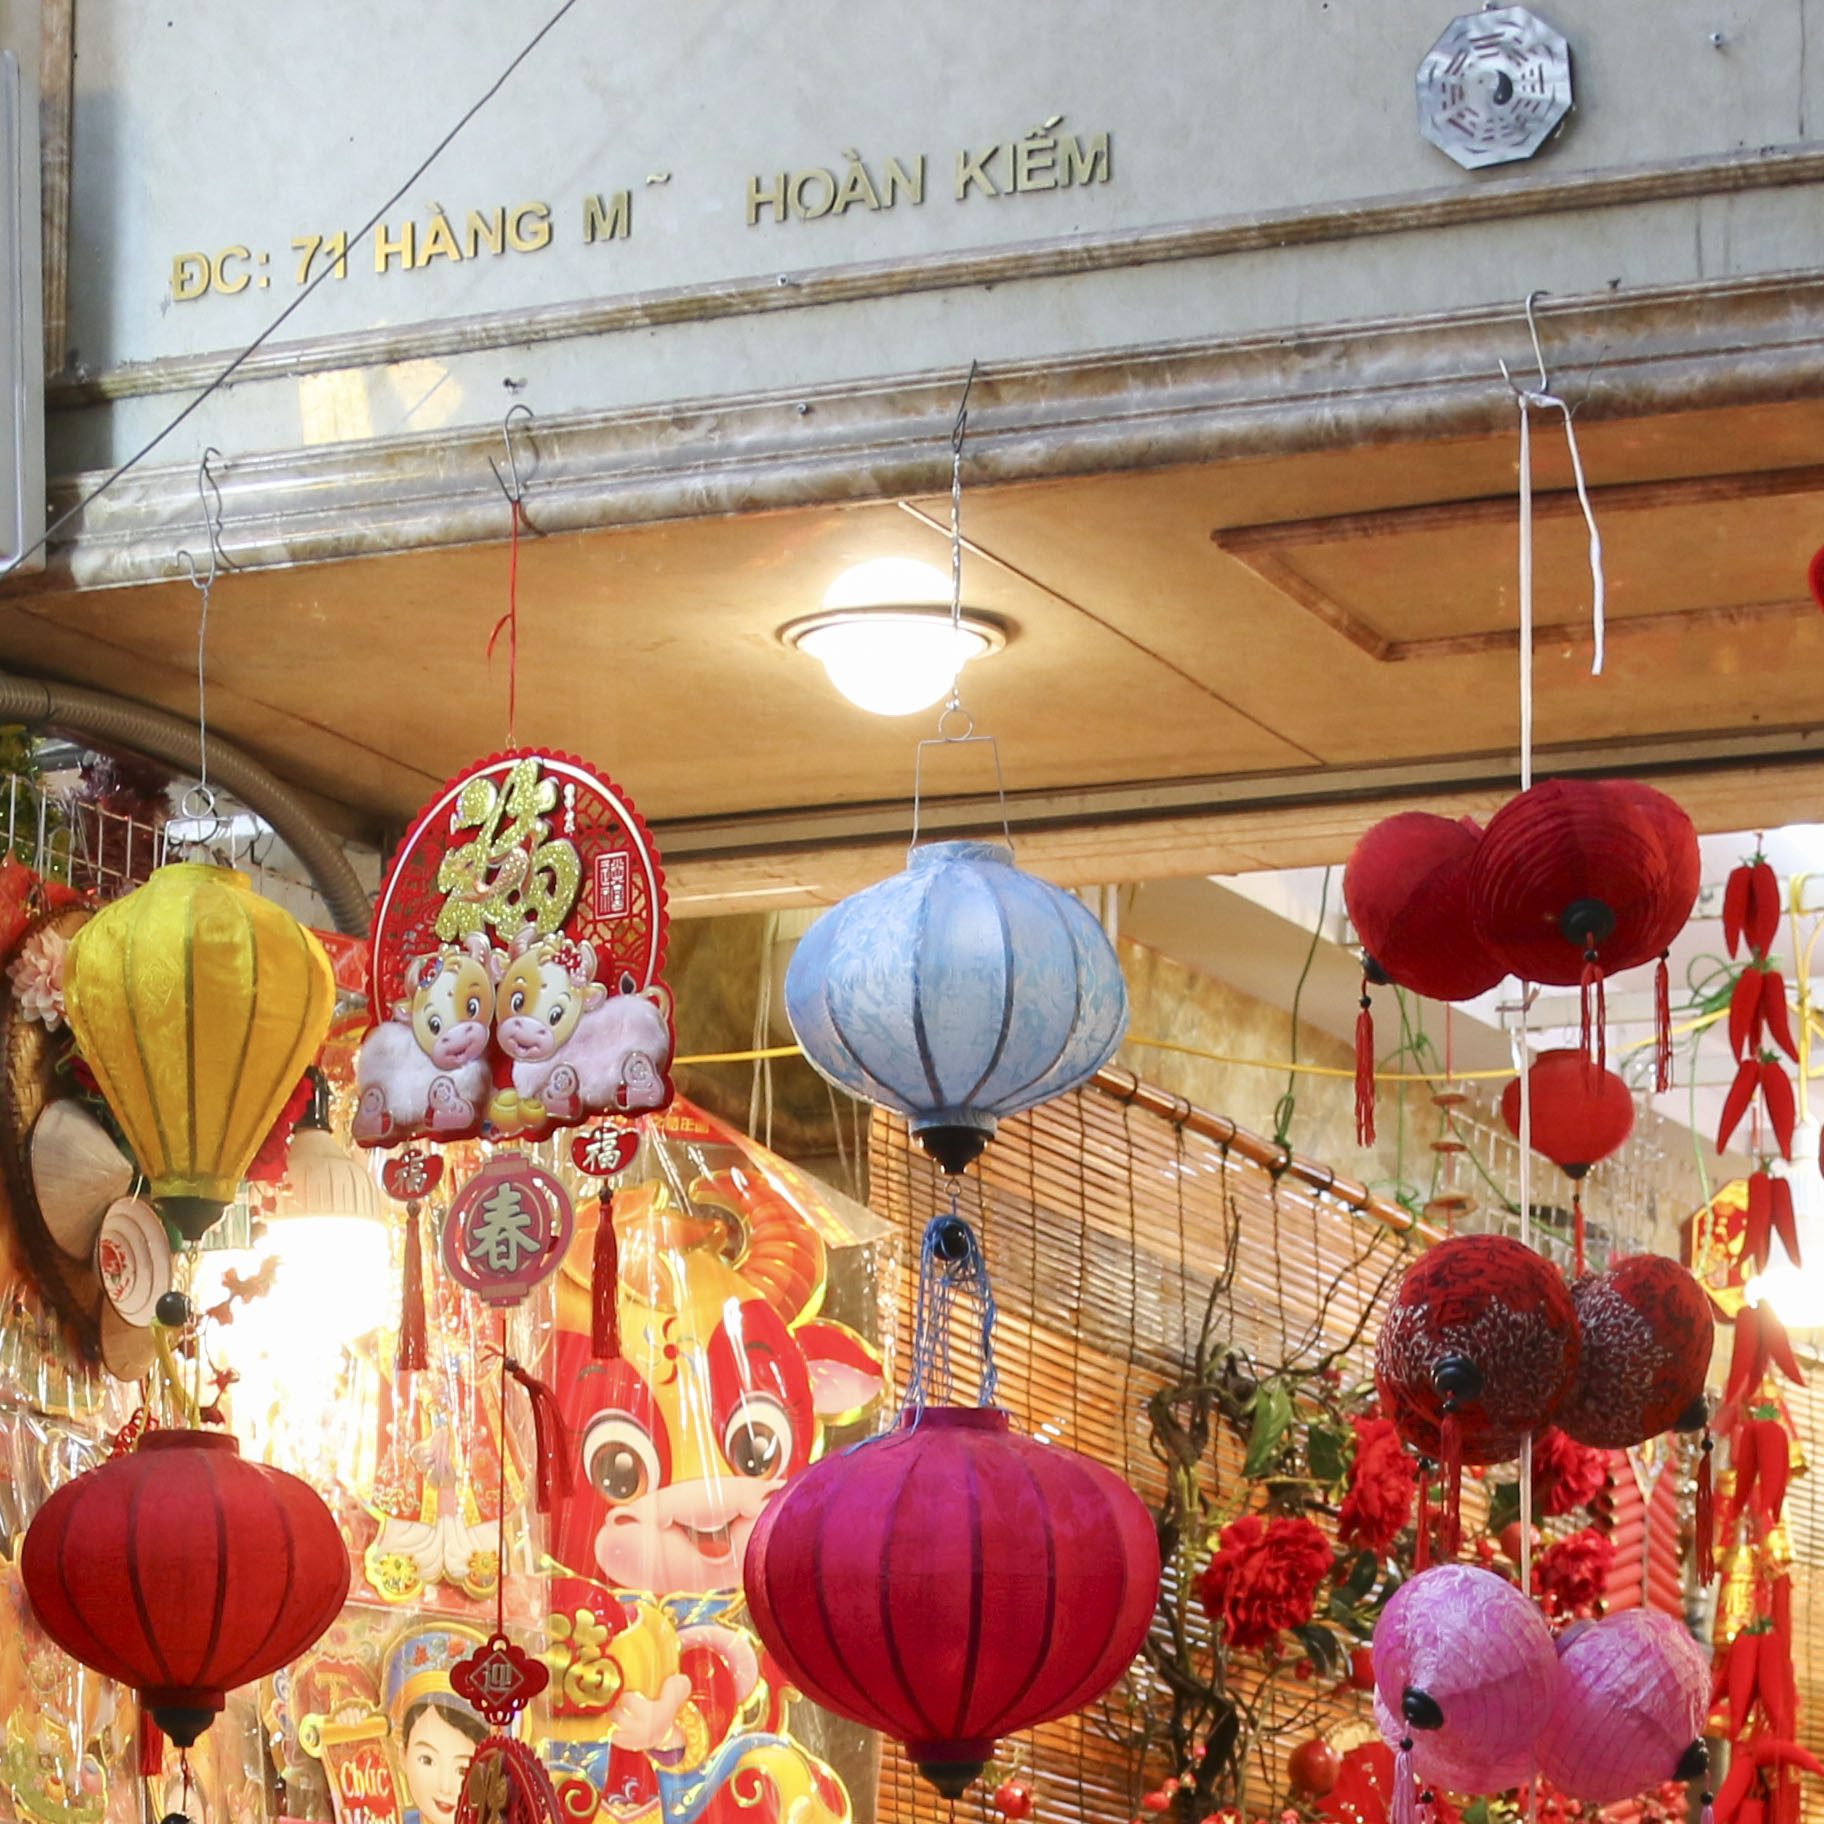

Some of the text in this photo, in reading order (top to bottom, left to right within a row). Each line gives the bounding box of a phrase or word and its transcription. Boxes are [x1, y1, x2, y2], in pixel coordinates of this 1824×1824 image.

[172, 247, 272, 303] ĐC:
[291, 229, 349, 287] 71
[372, 202, 552, 275] HÀNG
[746, 146, 925, 226] HOÀN
[954, 115, 1114, 200] KIẾM
[581, 1131, 625, 1173] 福
[470, 1181, 540, 1272] 春
[340, 1757, 389, 1798] Chúc
